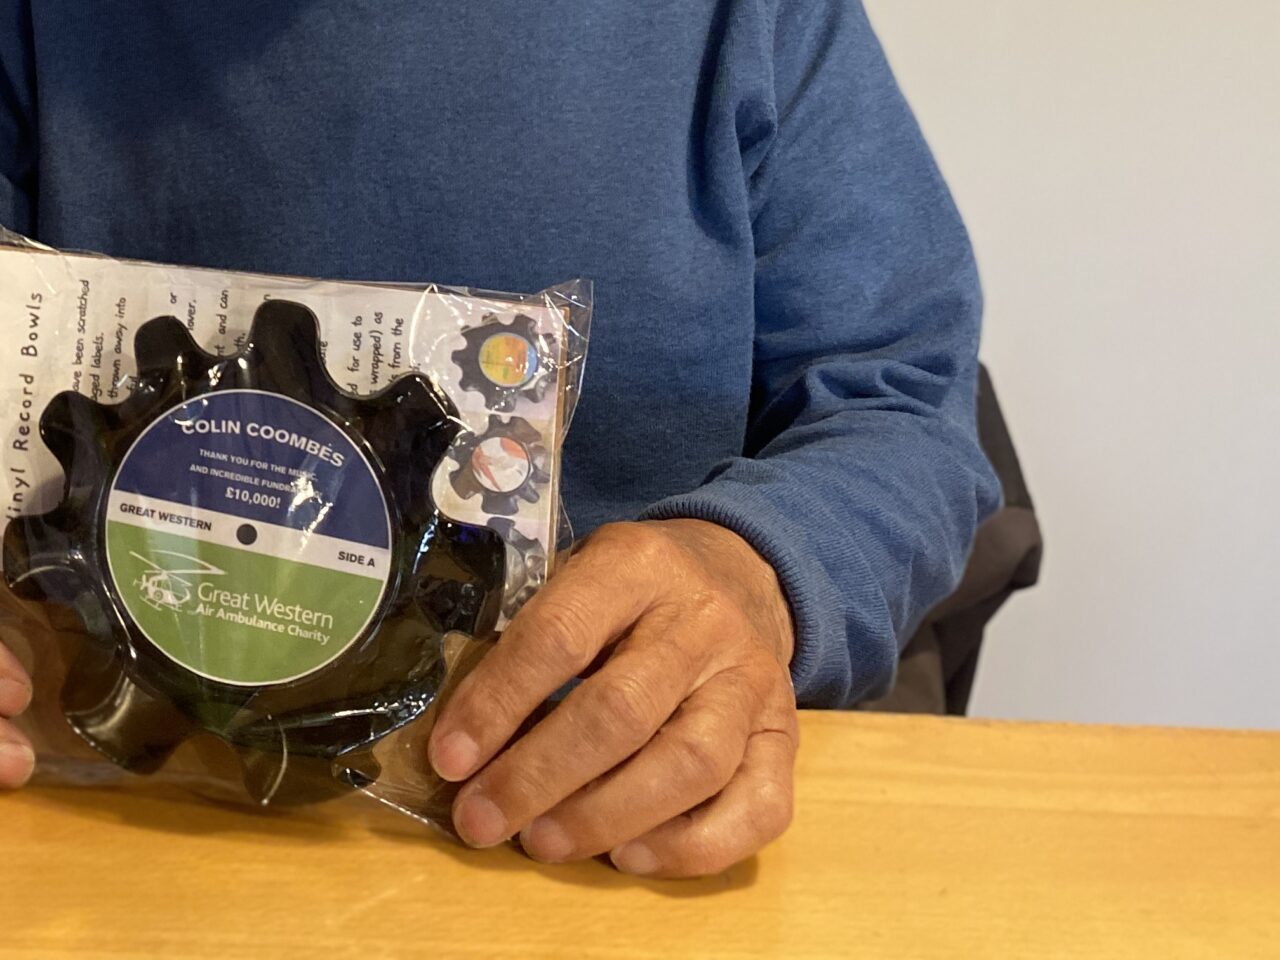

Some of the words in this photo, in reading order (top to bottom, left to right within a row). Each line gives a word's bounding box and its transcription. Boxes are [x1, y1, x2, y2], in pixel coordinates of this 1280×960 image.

[77, 279, 89, 334] scratched
[115, 296, 126, 318] into
[170, 292, 177, 304] or
[220, 289, 229, 309] can
[21, 292, 43, 357] Bowls
[216, 313, 227, 335] and
[351, 315, 363, 327] to
[374, 311, 383, 325] as
[391, 318, 404, 336] the
[72, 337, 84, 365] been
[91, 332, 104, 368] labels.
[114, 323, 128, 354] away
[353, 331, 362, 351] use
[347, 357, 360, 373] for
[369, 330, 384, 384] wrapped)
[388, 342, 401, 369] from
[73, 371, 82, 390] ave
[107, 359, 121, 399] thrown
[13, 373, 35, 451] Record
[181, 420, 241, 435] COLIN
[246, 422, 345, 467] COOMBES
[199, 448, 228, 462] THANK
[230, 455, 249, 466] YOU
[250, 459, 269, 470] FOR
[269, 463, 286, 474] THE
[189, 463, 209, 475] AND
[209, 468, 260, 486] INCREDIBLE
[225, 487, 281, 509] £10,000!
[119, 503, 156, 519] GREAT
[158, 511, 213, 531] WESTERN
[338, 550, 365, 565] SIDE
[366, 556, 376, 568] A
[197, 582, 251, 611] Great
[253, 593, 334, 629] Western
[195, 603, 214, 618] Air
[216, 608, 286, 634] Ambulance
[287, 623, 331, 646] Charity
